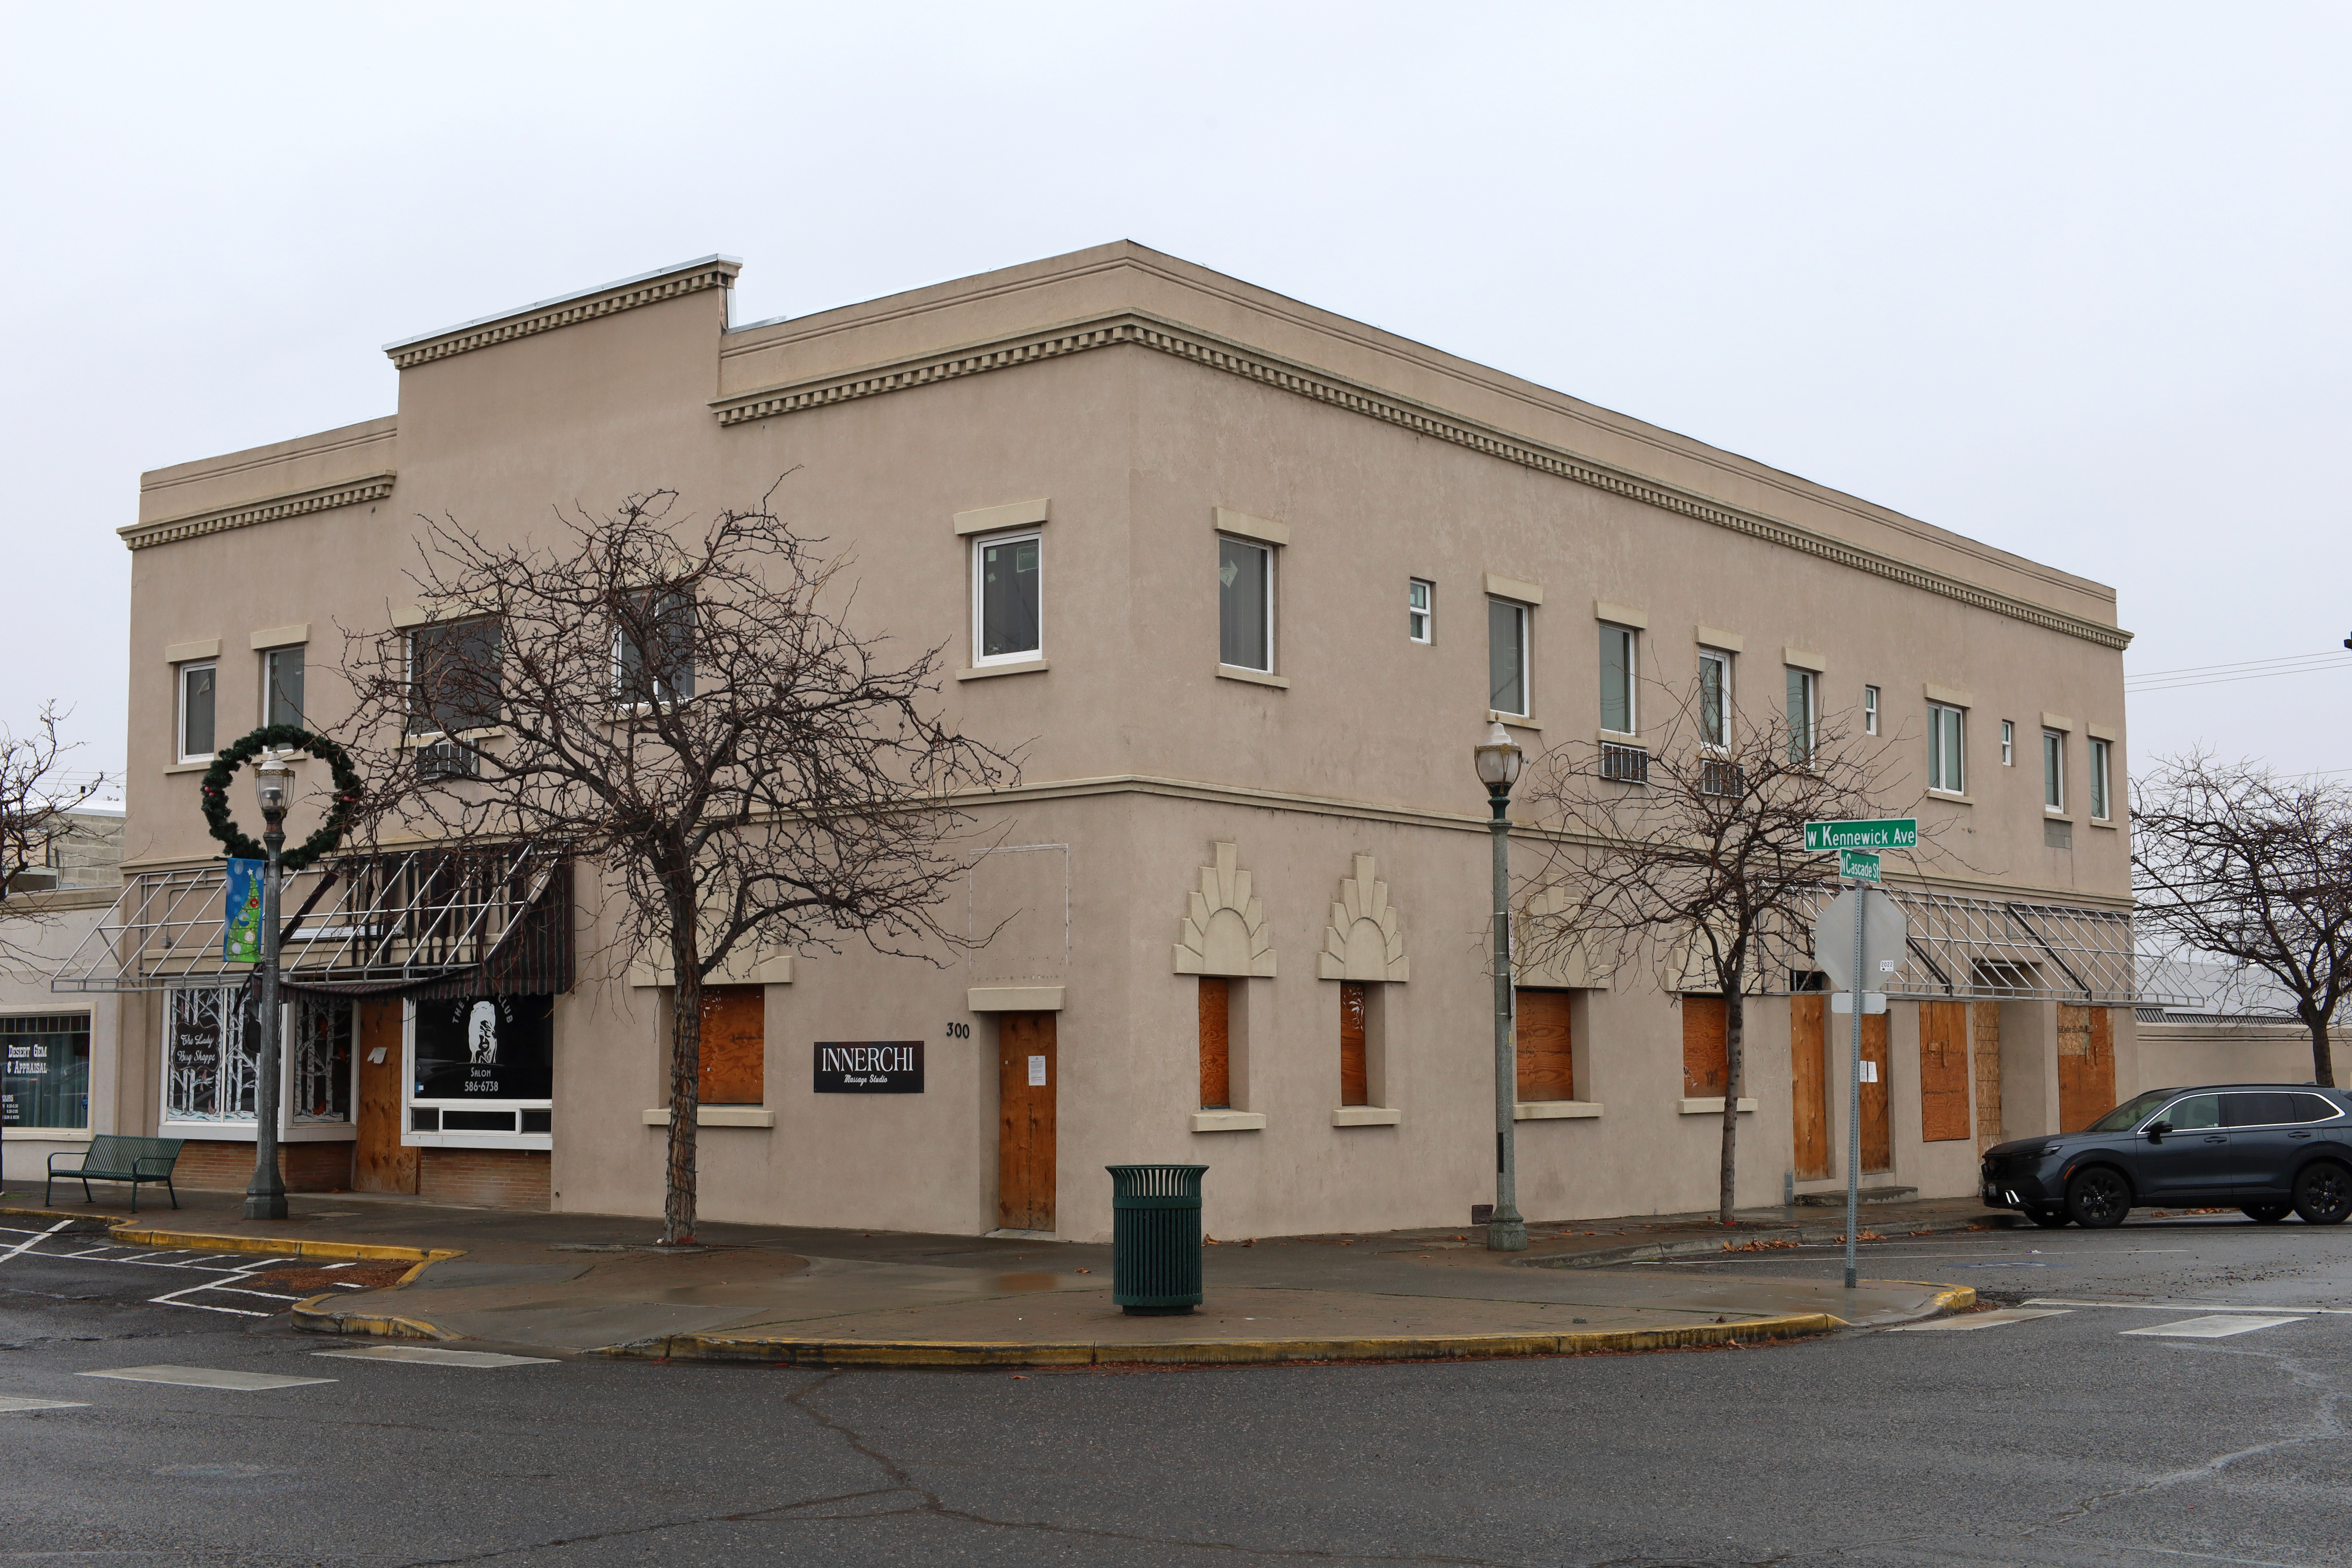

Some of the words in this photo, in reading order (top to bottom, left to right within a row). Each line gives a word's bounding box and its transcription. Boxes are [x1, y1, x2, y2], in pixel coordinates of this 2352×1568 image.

[1807, 831, 1817, 847] W
[1823, 825, 1888, 846] Kennewick
[1893, 828, 1914, 844] Ave
[1841, 857, 1845, 873] N
[1846, 853, 1872, 877] Cascade
[1873, 863, 1879, 879] St
[452, 1000, 465, 1023] THE
[498, 994, 513, 1023] CLUB
[946, 1022, 970, 1039] 300
[181, 1034, 194, 1046] The
[194, 1033, 214, 1048] Lady
[8, 1044, 30, 1058] DESERT
[34, 1044, 47, 1057] GEM
[177, 1050, 192, 1066] Bug
[194, 1050, 215, 1064] Shoppe
[14, 1061, 47, 1073] APPRAISAL
[822, 1047, 913, 1072] INNERCHI
[471, 1067, 491, 1077] SALON
[464, 1081, 498, 1091] 586-6738
[844, 1074, 867, 1086] Massage
[869, 1074, 888, 1083] Studio
